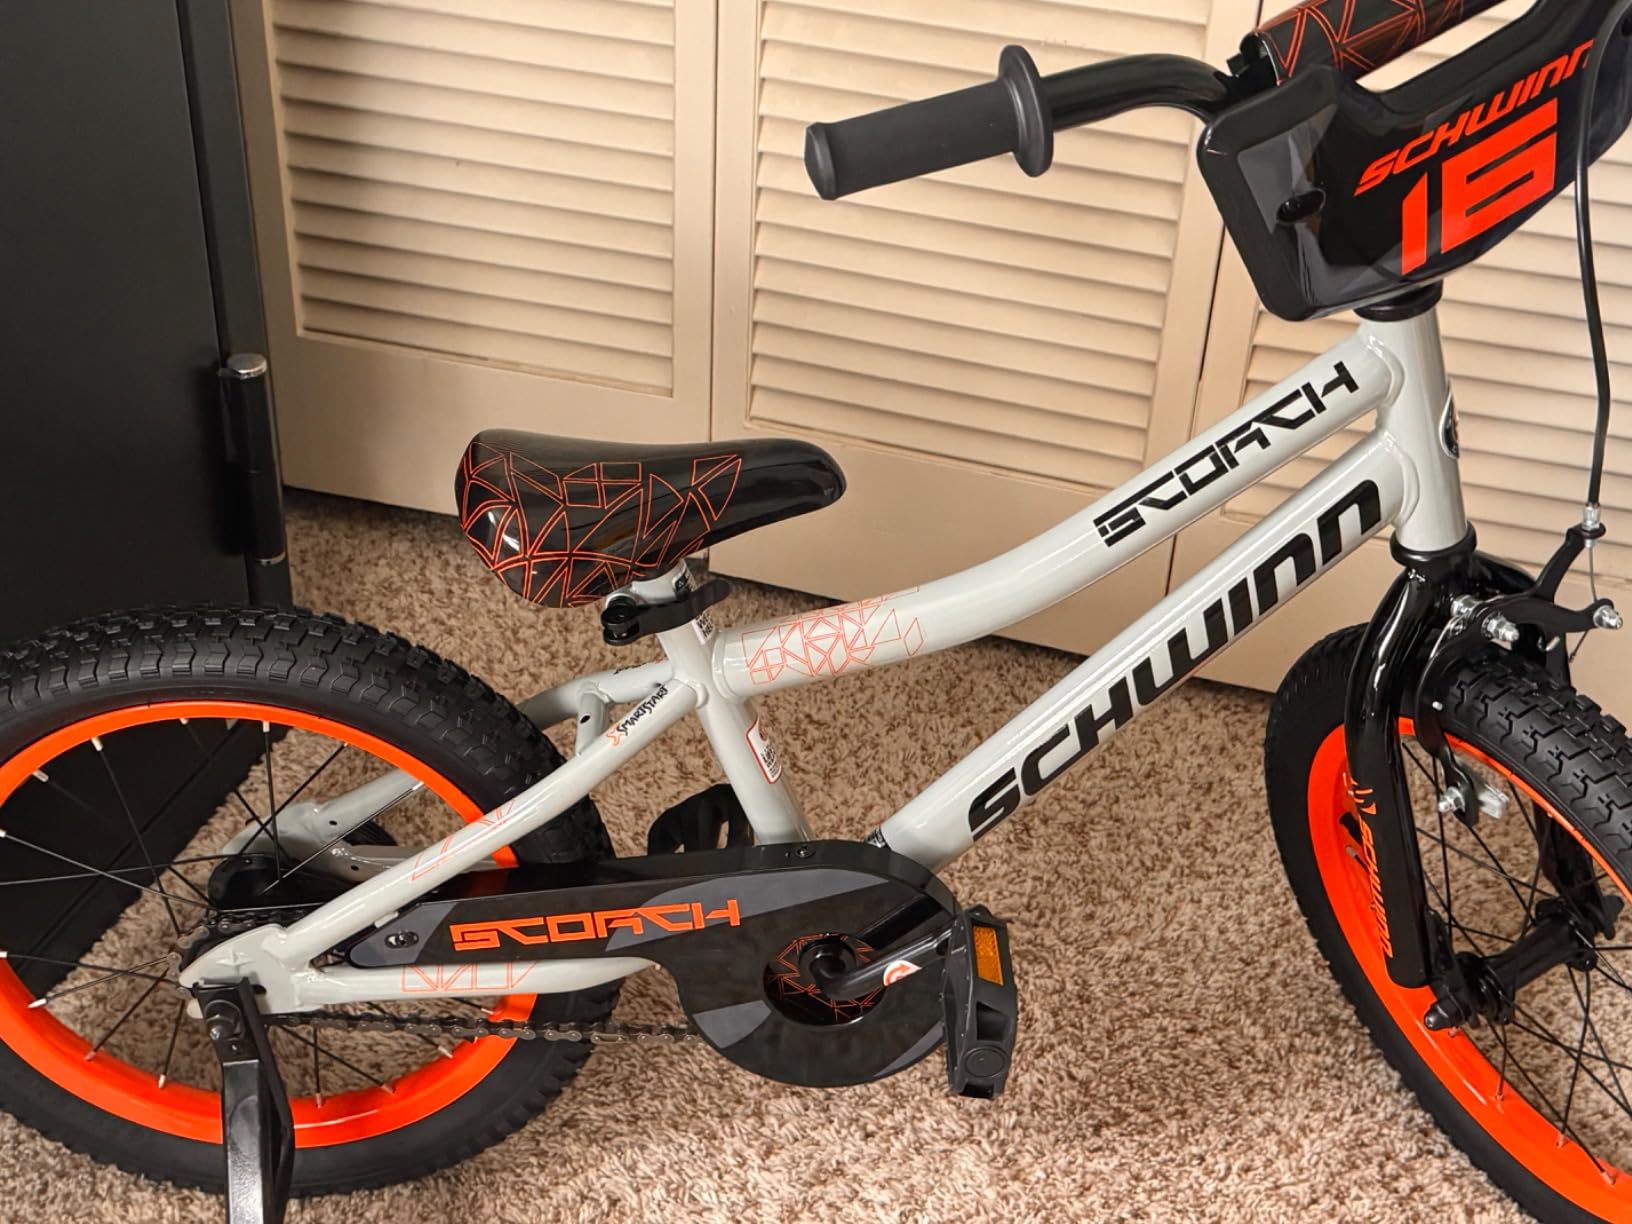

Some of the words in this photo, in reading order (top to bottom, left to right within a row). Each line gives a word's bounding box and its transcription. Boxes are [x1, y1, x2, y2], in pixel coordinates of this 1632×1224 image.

[1402, 97, 1558, 275] 16
[1093, 361, 1359, 547] SCORCH
[968, 479, 1382, 842] SCHWINN
[449, 899, 741, 951] SCORCH
